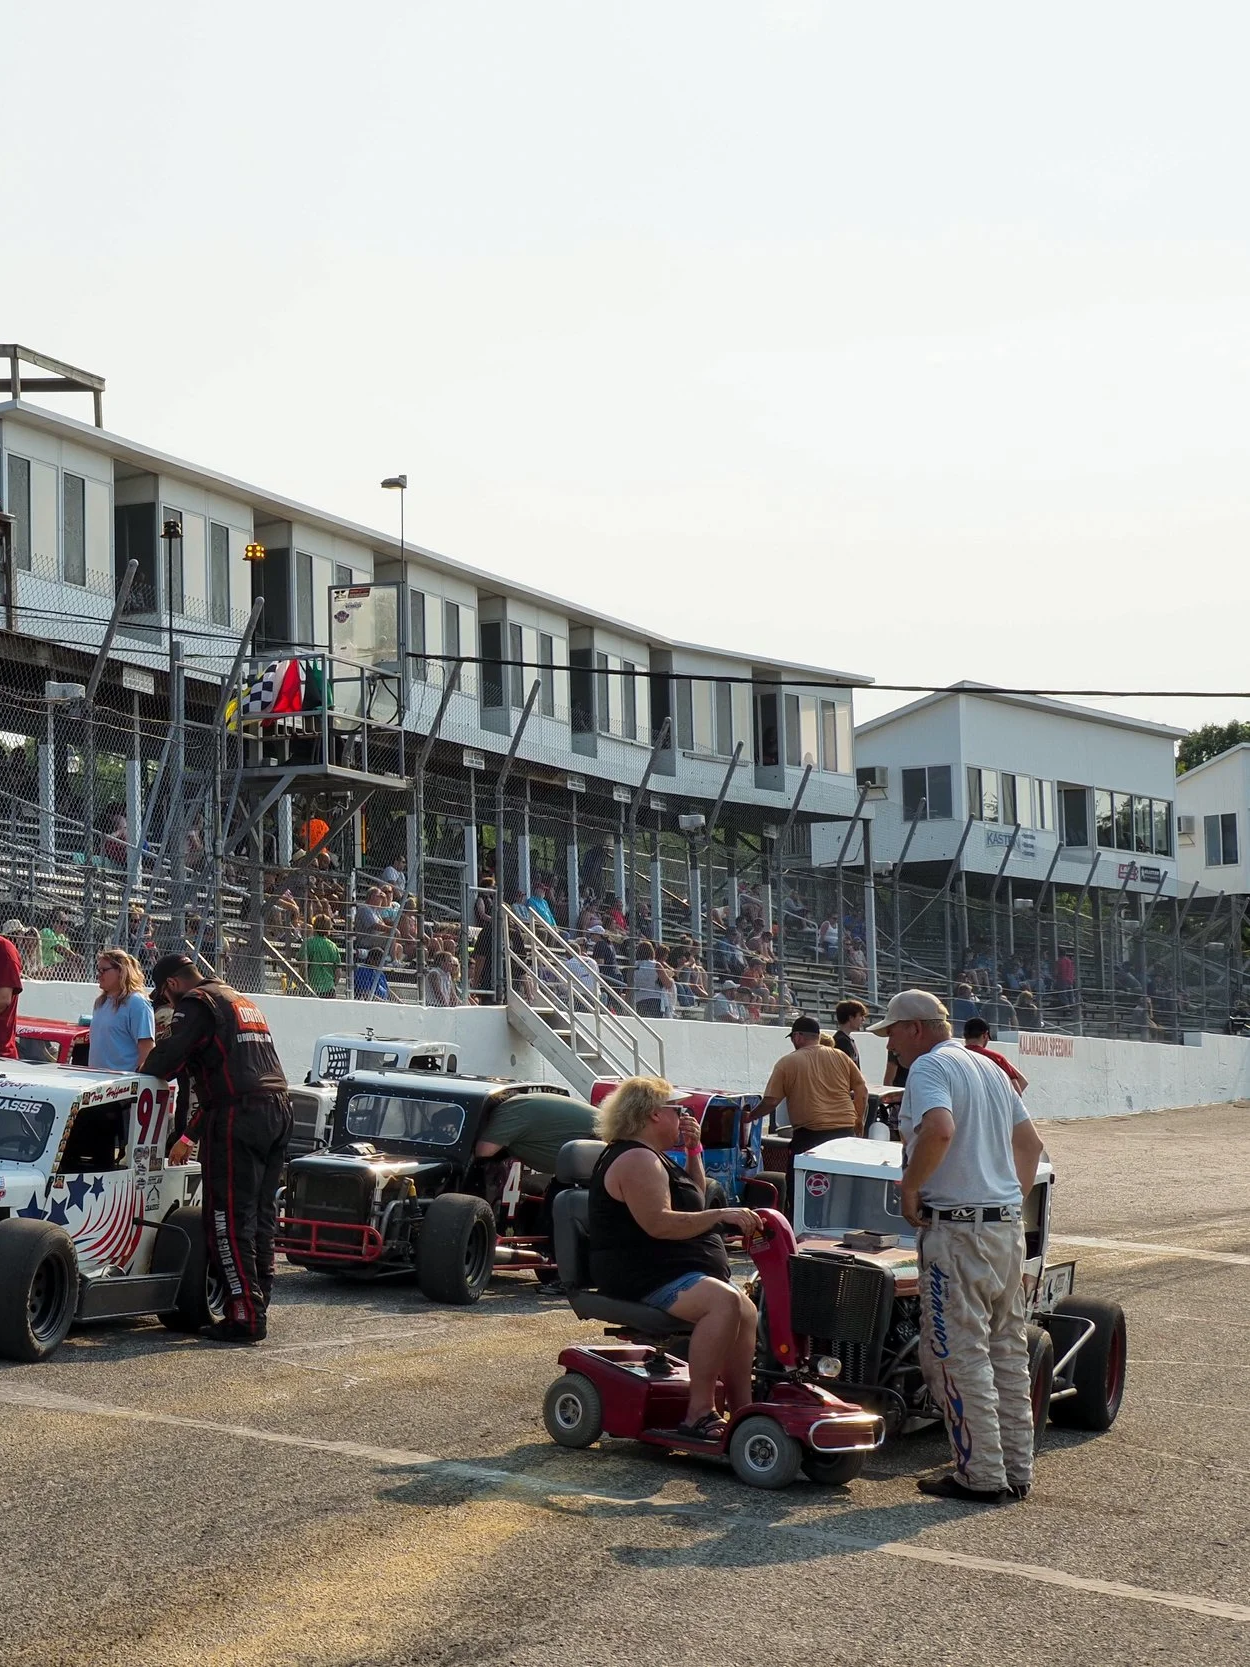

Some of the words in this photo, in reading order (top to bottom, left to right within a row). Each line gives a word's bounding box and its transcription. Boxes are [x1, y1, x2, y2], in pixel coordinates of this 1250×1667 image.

[137, 1088, 170, 1145] 97
[214, 1210, 227, 1236] AWAY
[217, 1238, 234, 1265] BUGS
[225, 1265, 243, 1295] DRIVE
[930, 1262, 949, 1358] Con-way
